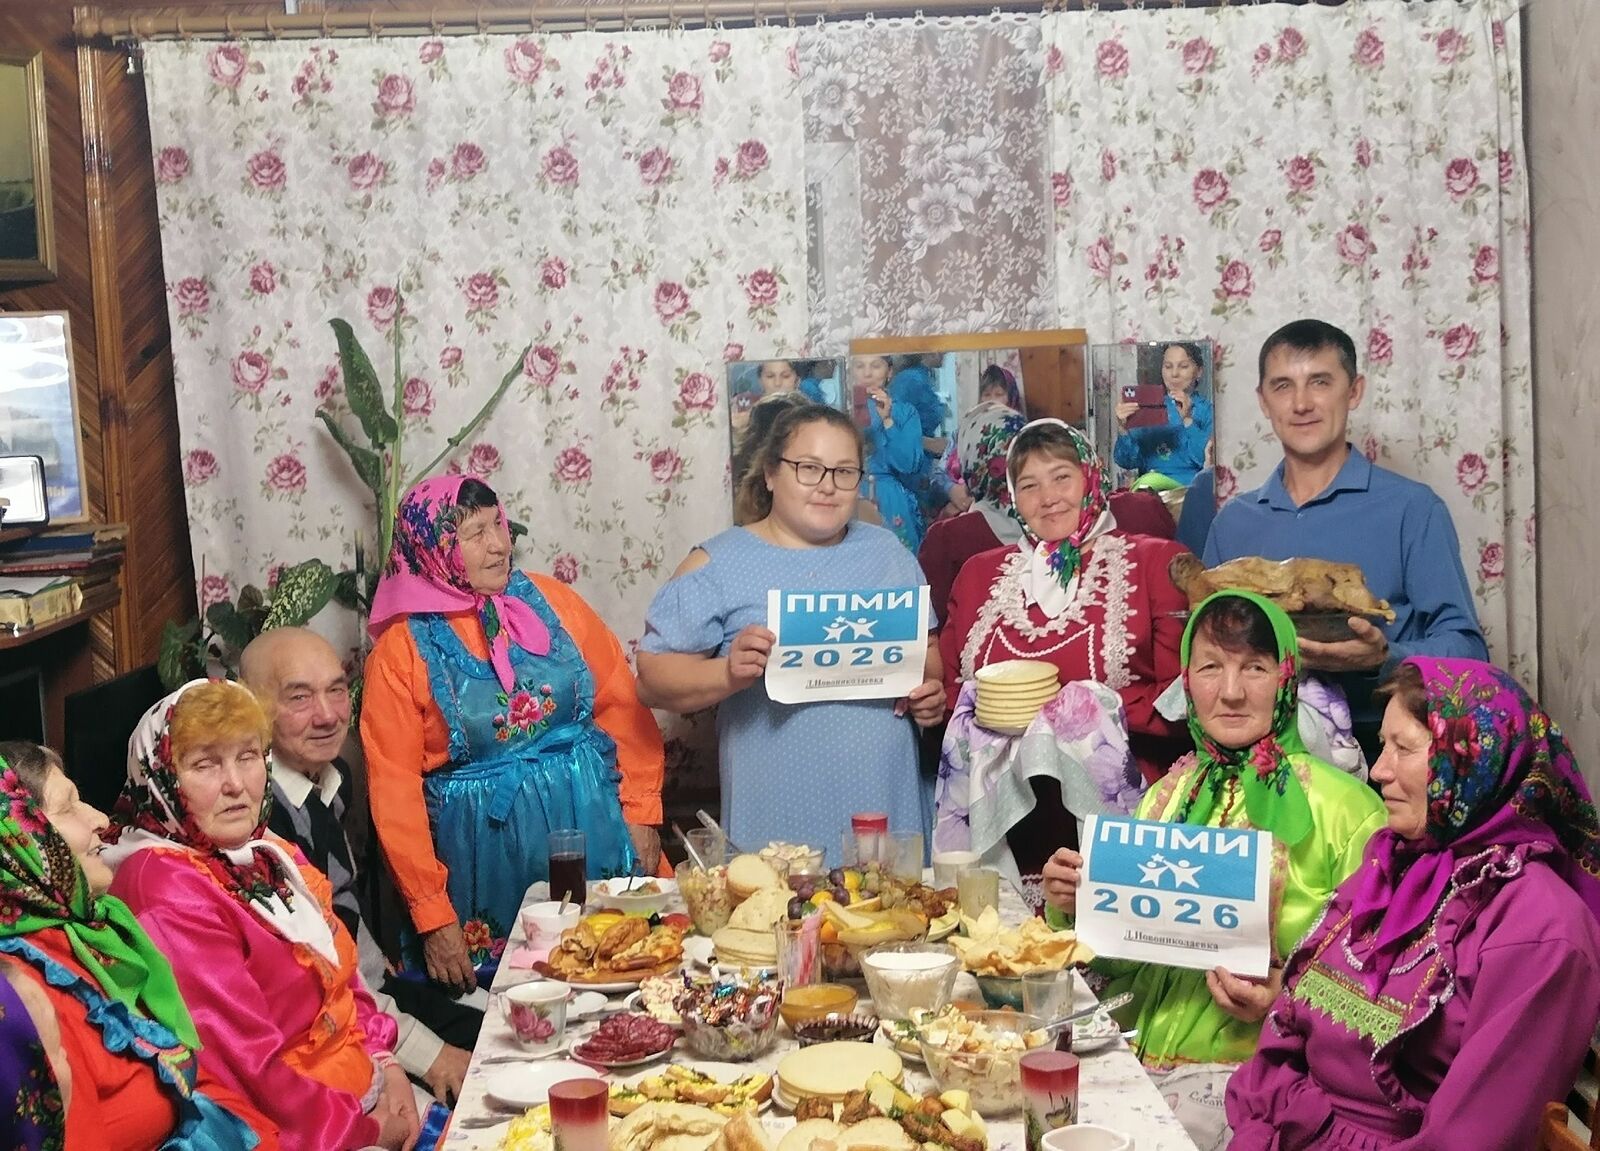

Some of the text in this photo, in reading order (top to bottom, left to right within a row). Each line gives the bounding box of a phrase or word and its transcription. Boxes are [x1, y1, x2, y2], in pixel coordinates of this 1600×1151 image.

[787, 590, 913, 613] ППМИ
[780, 646, 904, 669] 2026
[1100, 820, 1249, 857] ППМИ
[1093, 888, 1239, 929] 2026
